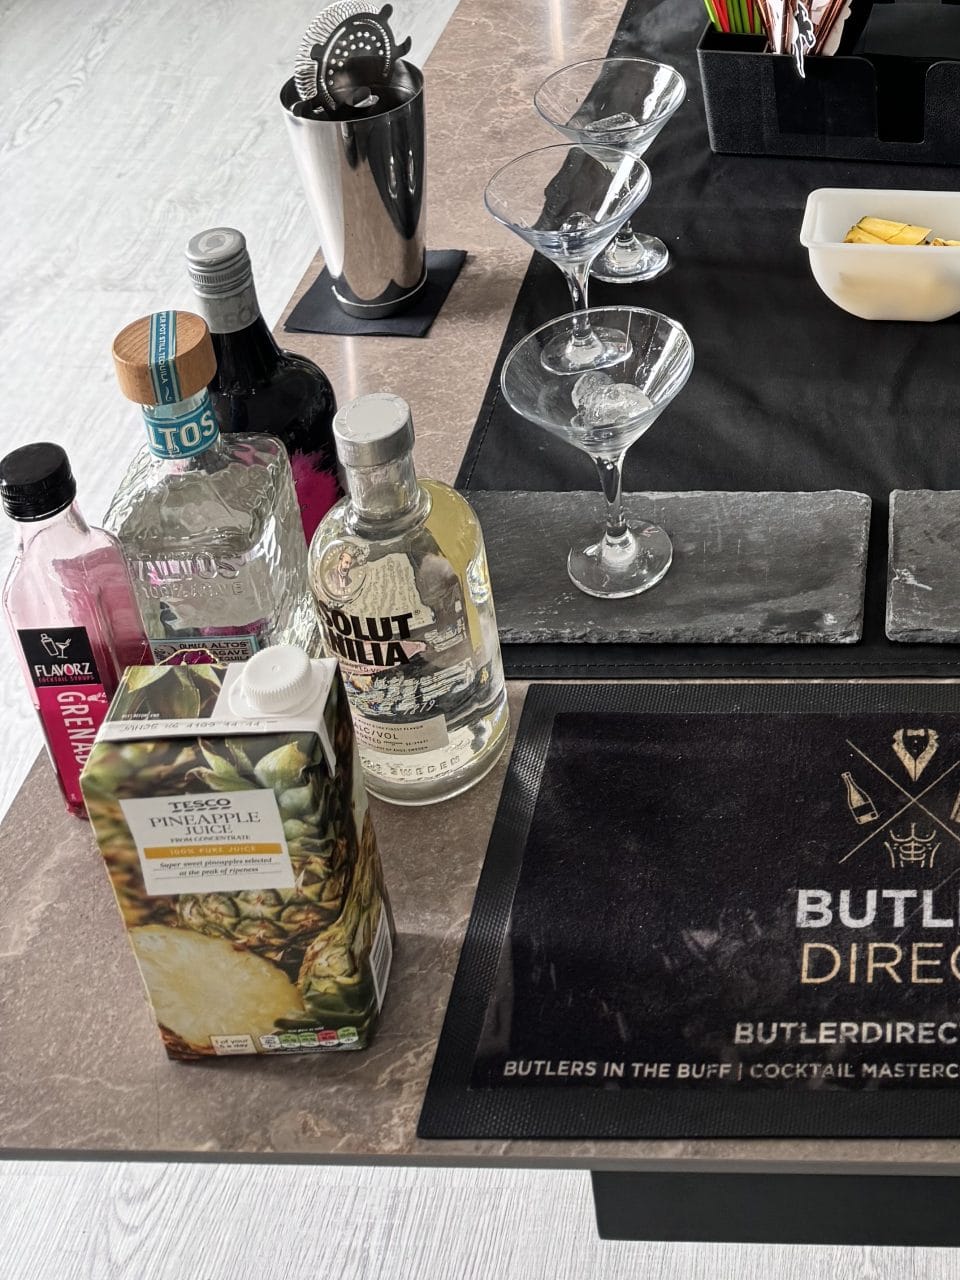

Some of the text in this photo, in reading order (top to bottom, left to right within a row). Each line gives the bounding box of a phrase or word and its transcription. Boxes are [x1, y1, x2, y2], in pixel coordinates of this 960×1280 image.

[211, 641, 248, 649] ALTOS
[34, 662, 93, 677] FLAVORZ
[57, 691, 96, 770] GRENAD
[168, 798, 232, 810] TESCO
[149, 811, 261, 828] PINEAPPLE
[185, 824, 233, 836] JUICE
[194, 835, 250, 843] CONCENTRATE
[228, 845, 257, 853] JUICE
[160, 861, 181, 870] Super
[204, 859, 243, 868] pineapples
[503, 1060, 598, 1077] BUTLERS
[603, 1061, 626, 1078] IN
[631, 1062, 672, 1079] THE
[677, 1062, 733, 1079] BUFF
[750, 1063, 855, 1080] COCKTAIL
